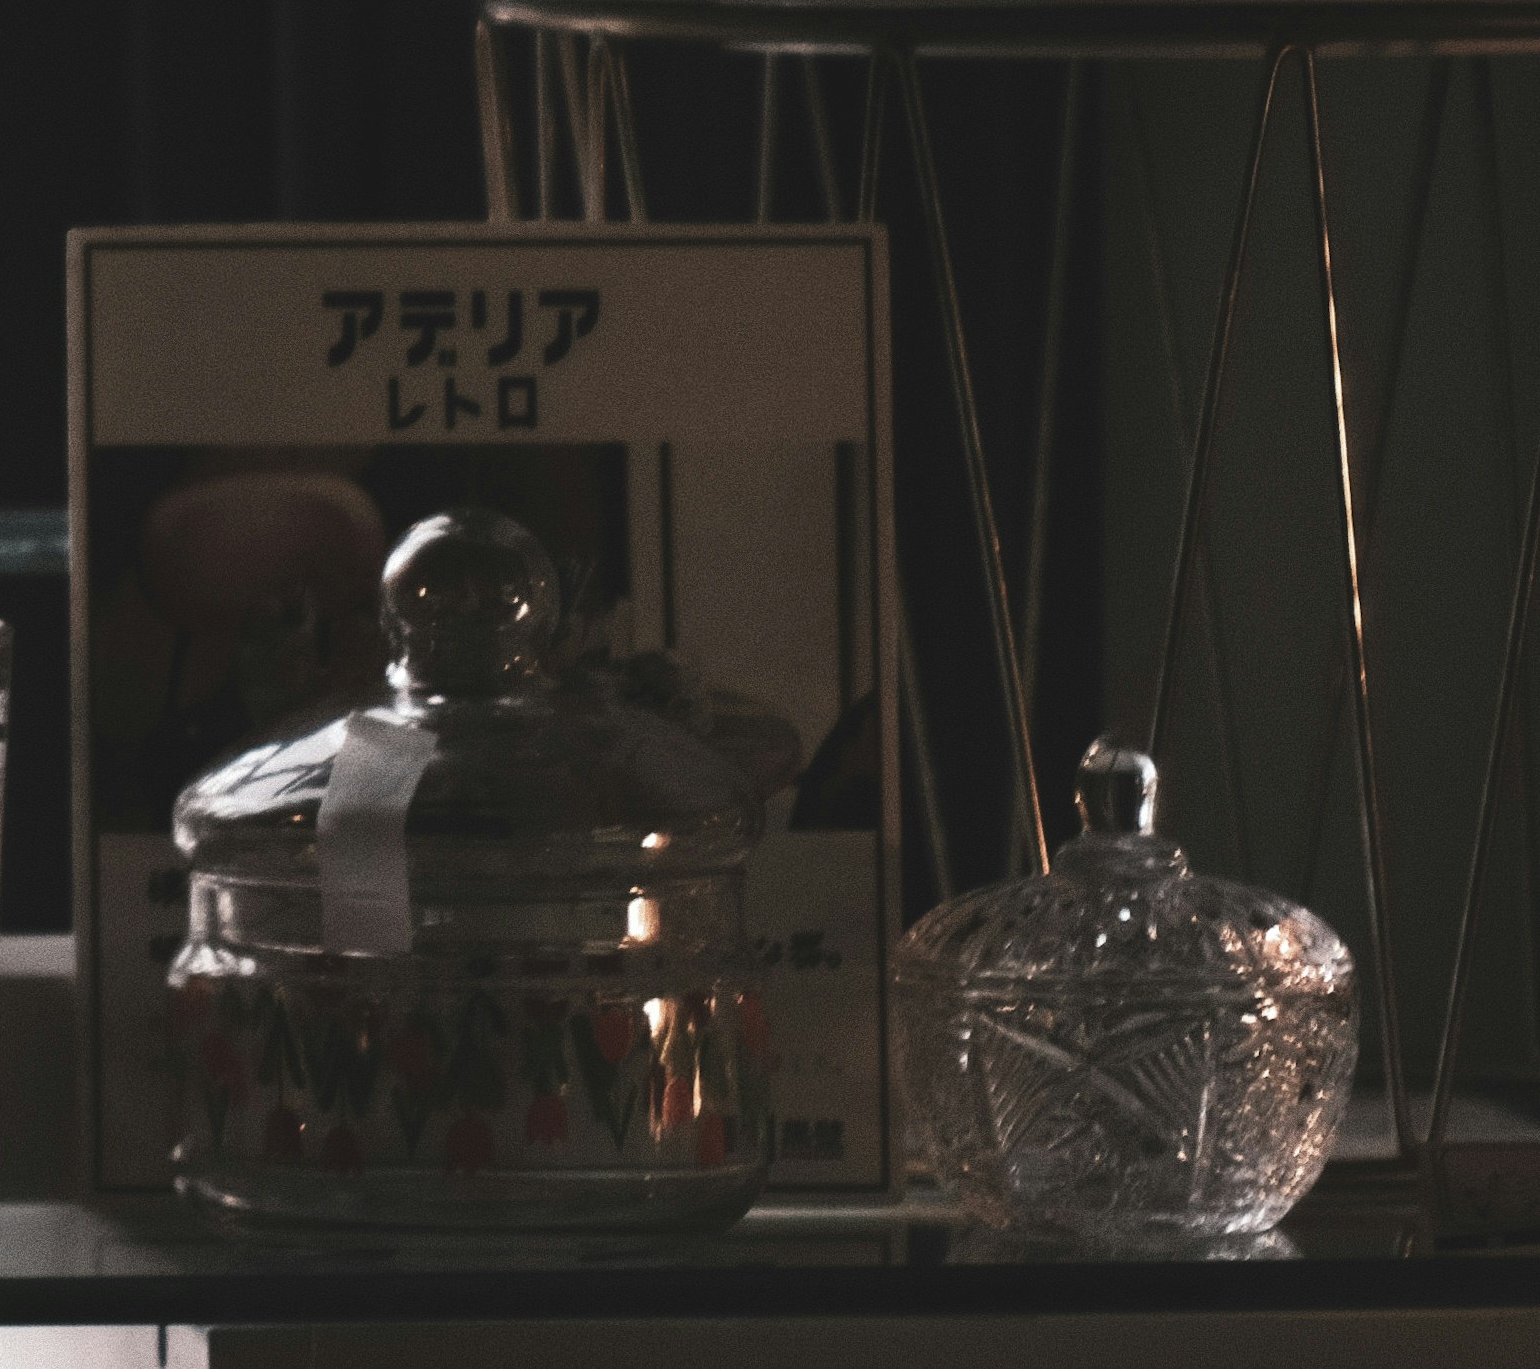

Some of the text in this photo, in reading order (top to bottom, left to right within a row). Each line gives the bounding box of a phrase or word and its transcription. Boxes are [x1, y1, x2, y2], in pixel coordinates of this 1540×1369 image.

[322, 288, 600, 368] アデリア
[387, 377, 539, 431] レトロ
